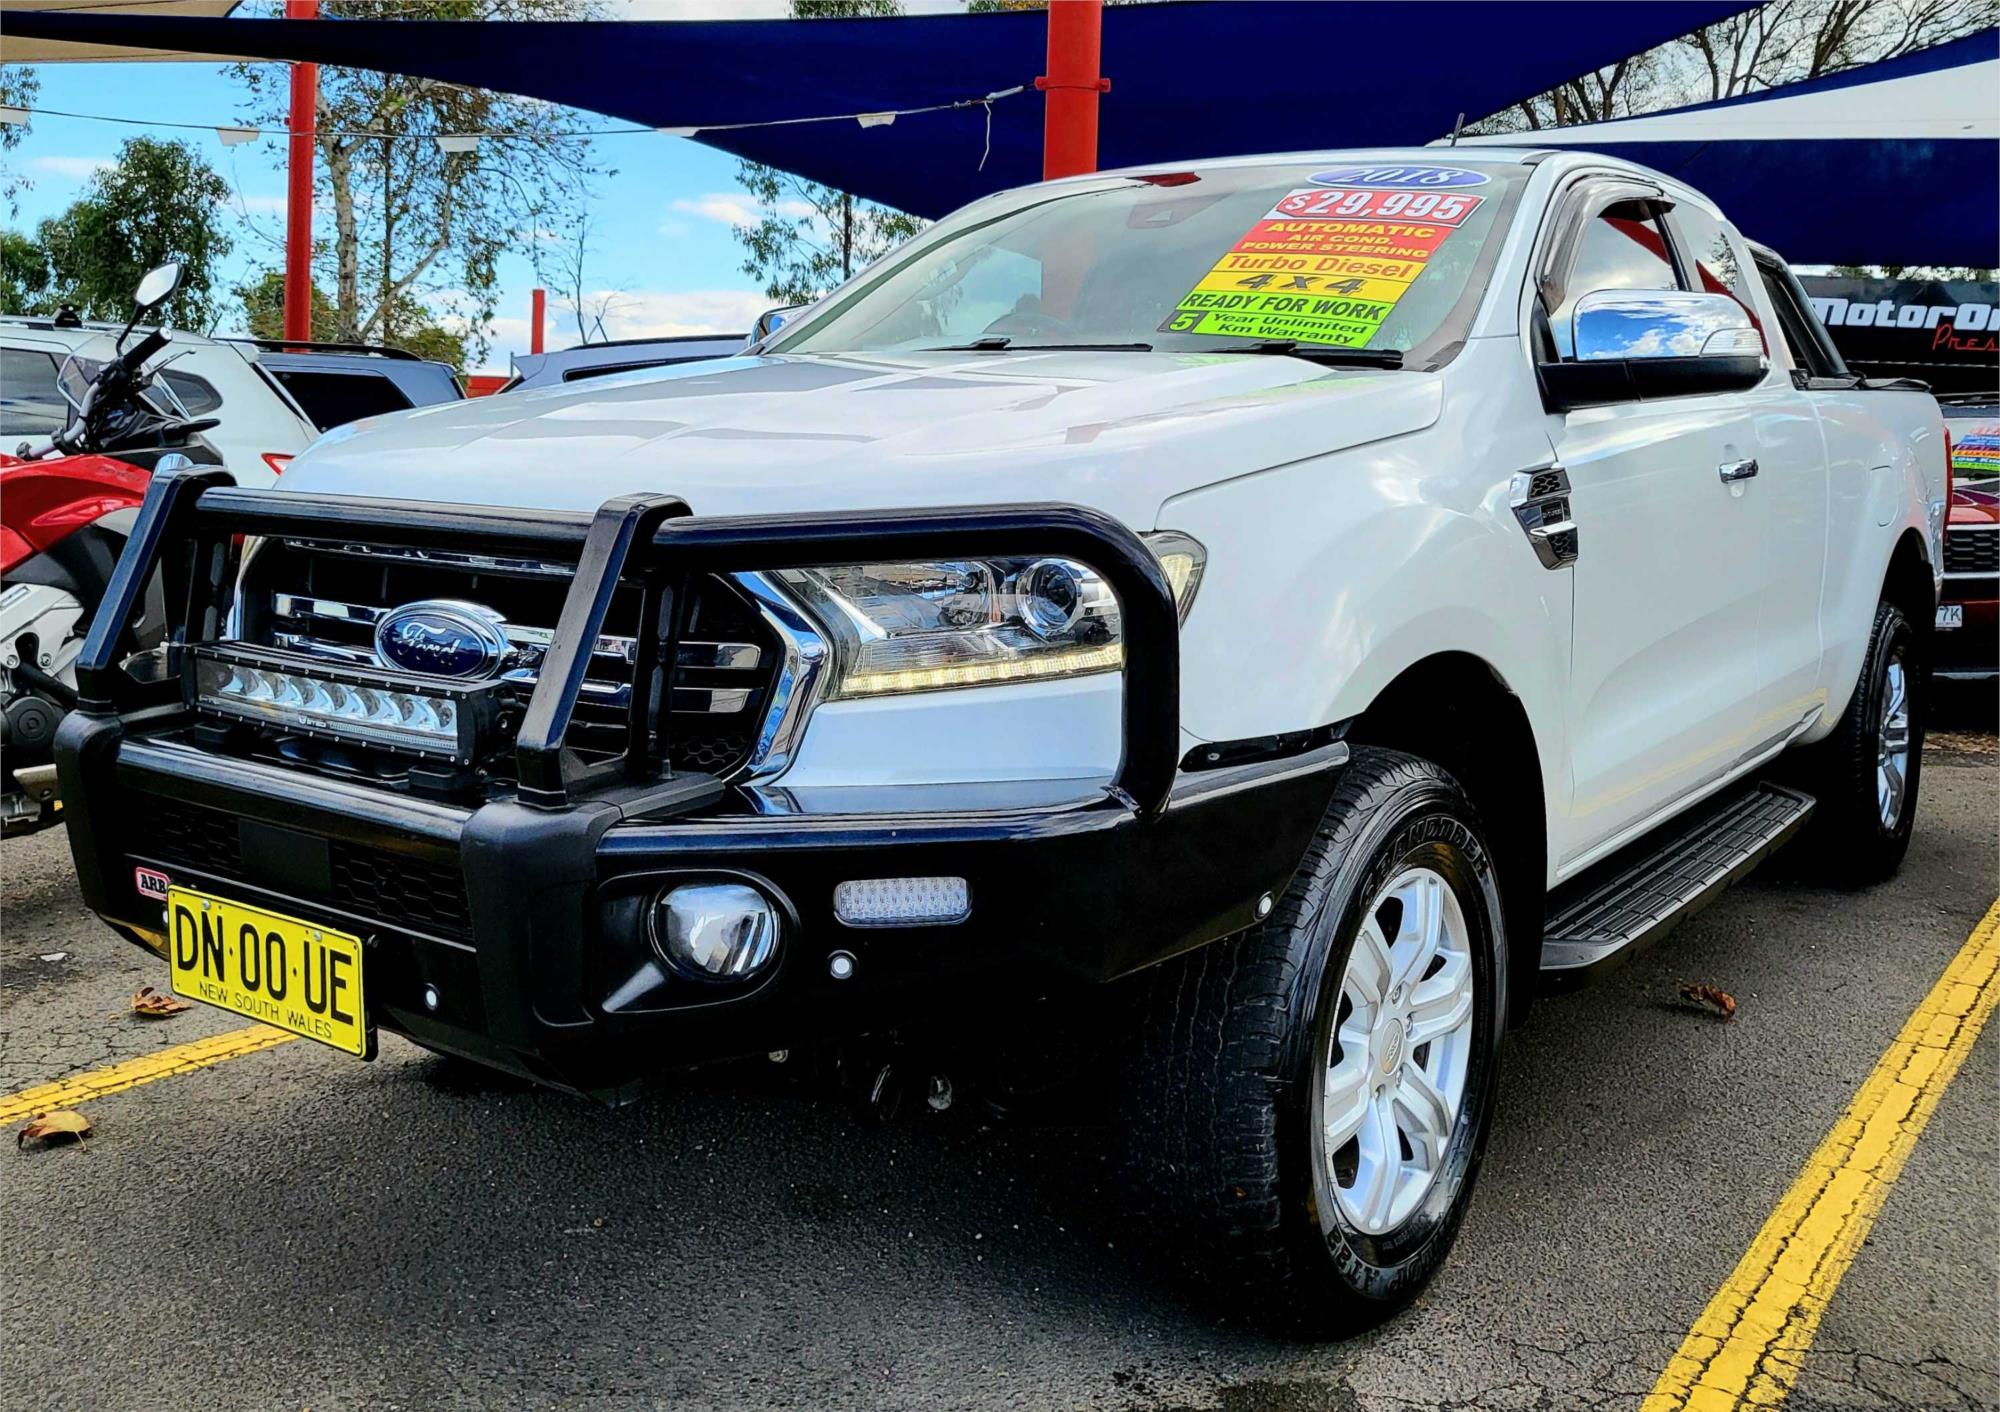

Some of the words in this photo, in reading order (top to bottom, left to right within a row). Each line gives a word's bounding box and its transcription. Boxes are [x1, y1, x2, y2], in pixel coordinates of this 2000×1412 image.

[1331, 168, 1463, 183] 2018
[1285, 191, 1473, 219] $29,995
[1265, 222, 1436, 238] AUTOMATIC
[1288, 234, 1325, 242] AIR
[1329, 235, 1394, 245] COND.
[1241, 241, 1315, 251] POWER
[1319, 243, 1429, 258] STEERING
[1226, 255, 1308, 271] Turbo
[1314, 256, 1414, 278] Diesel
[1182, 293, 1256, 312] READY
[1258, 296, 1311, 314] FOR
[1310, 299, 1387, 321] WORK
[1169, 313, 1200, 331] 5
[1211, 313, 1259, 324] Year
[1260, 315, 1367, 334] Unlimited
[1217, 323, 1251, 334] Km
[1255, 327, 1356, 345] Warranty
[141, 873, 167, 894] ARB
[199, 981, 228, 1001] NEW
[234, 992, 279, 1019] SOUTH
[286, 1009, 333, 1039] WALES
